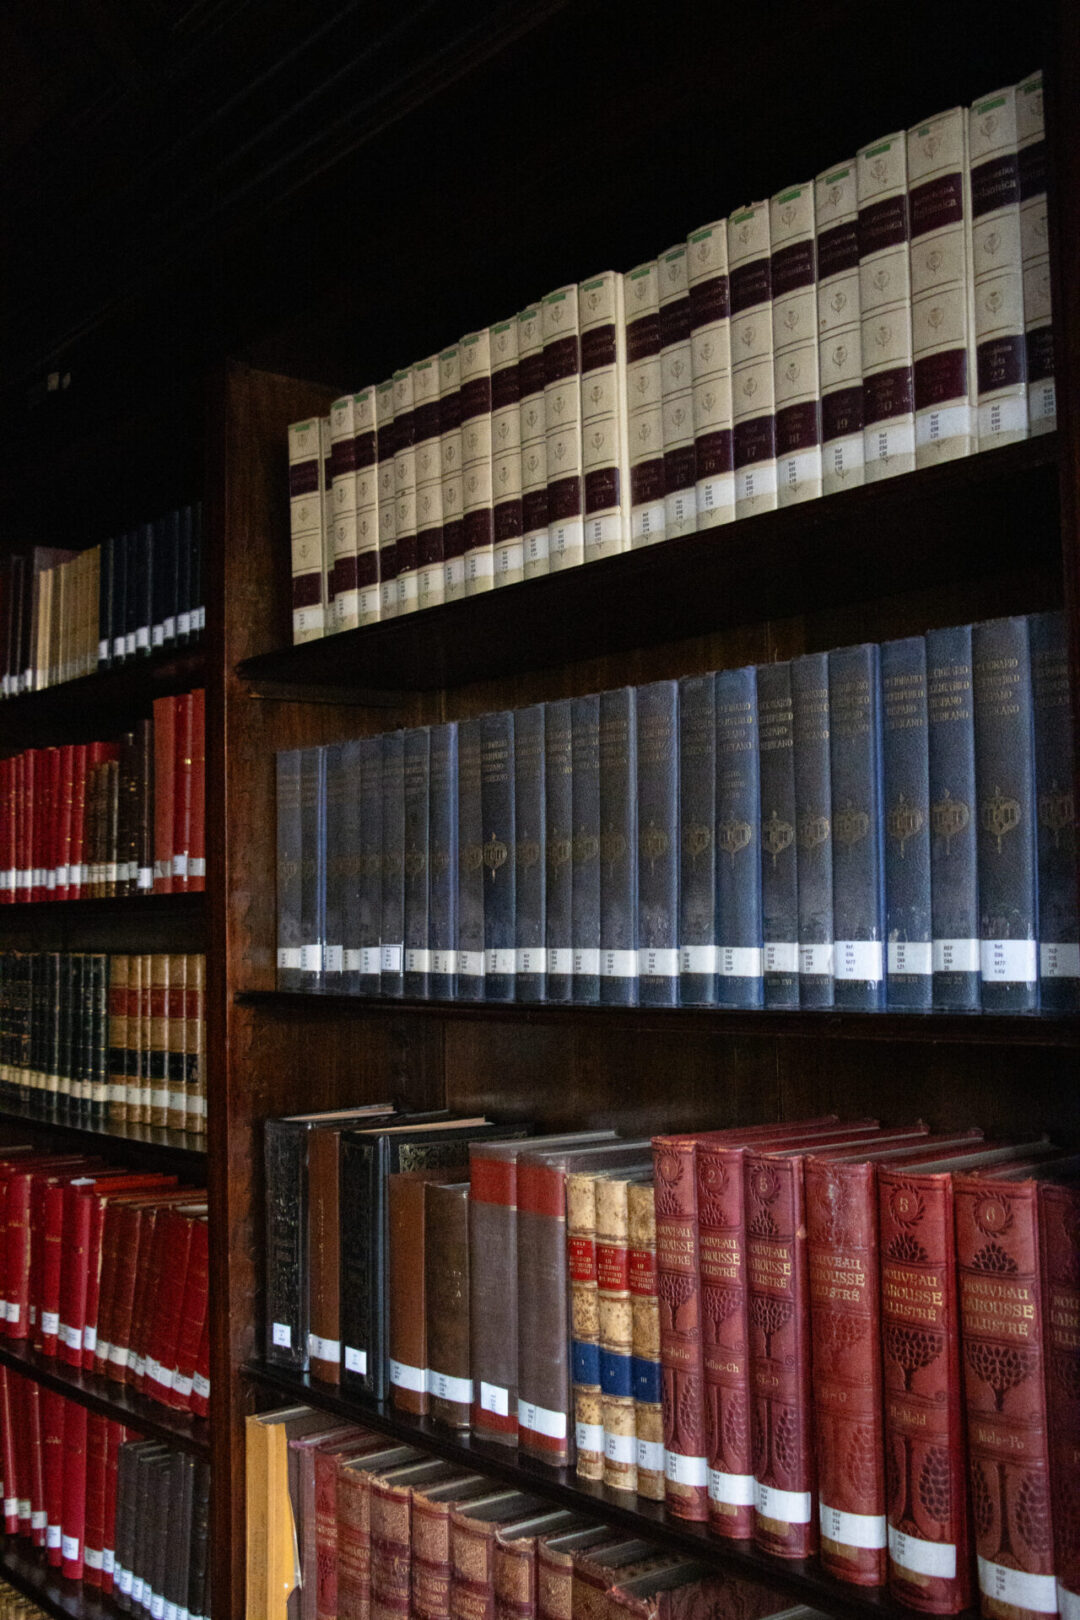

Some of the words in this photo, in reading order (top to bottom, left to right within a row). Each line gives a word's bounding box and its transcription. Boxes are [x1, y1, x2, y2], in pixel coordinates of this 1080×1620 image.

[658, 1238, 695, 1254] ROUSSE
[700, 1249, 741, 1265] ROUSSE
[810, 1254, 862, 1271] OUVEAU
[750, 1257, 792, 1276] AROUSSE
[810, 1267, 866, 1288] ROUSSE
[810, 1285, 861, 1303] LUSTRÉ
[882, 1283, 943, 1307] AROUSSE
[964, 1280, 1029, 1300] NOUVEAU
